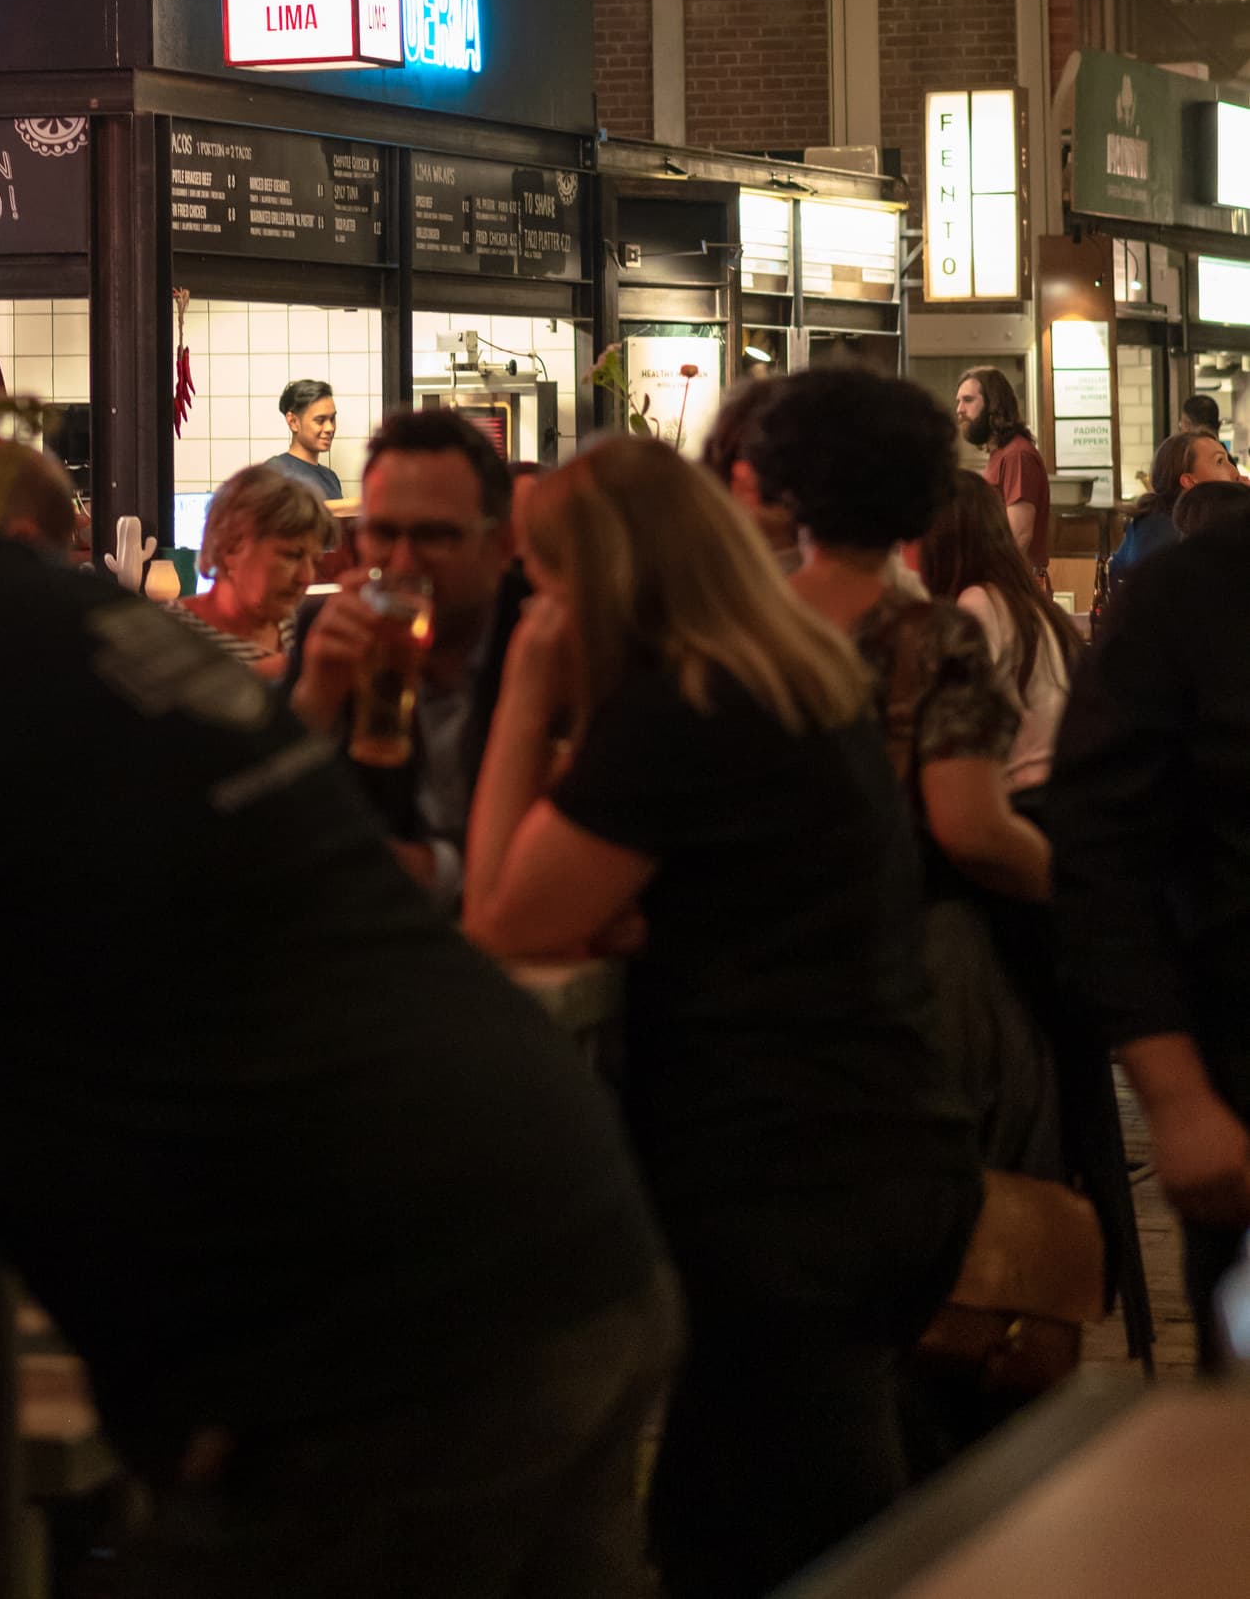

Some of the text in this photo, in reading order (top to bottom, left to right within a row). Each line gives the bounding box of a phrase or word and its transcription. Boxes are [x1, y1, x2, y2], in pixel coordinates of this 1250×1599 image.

[266, 4, 318, 31] LIMA
[368, 6, 387, 30] LIMA
[172, 132, 192, 155] ACOS
[940, 112, 956, 275] FENTO
[535, 194, 555, 218] SHARE
[539, 231, 559, 251] PLATTER
[641, 369, 673, 377] HEALTHY
